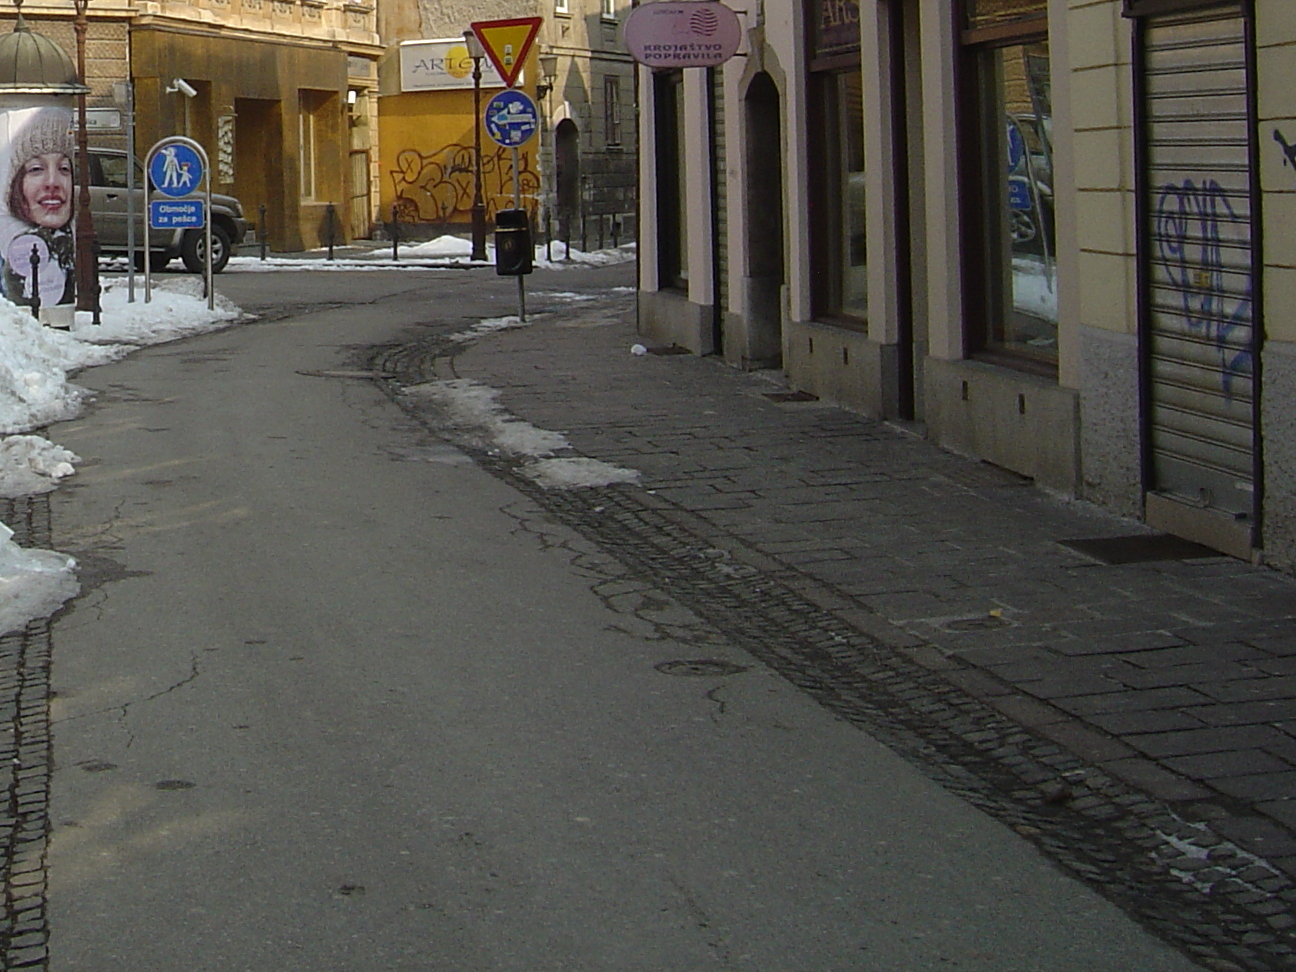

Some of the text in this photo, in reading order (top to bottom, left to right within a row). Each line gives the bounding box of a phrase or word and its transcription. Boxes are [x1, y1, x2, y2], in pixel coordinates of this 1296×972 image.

[644, 52, 722, 61] POPRAVILA
[159, 204, 196, 214] Območje
[172, 214, 197, 225] pešce
